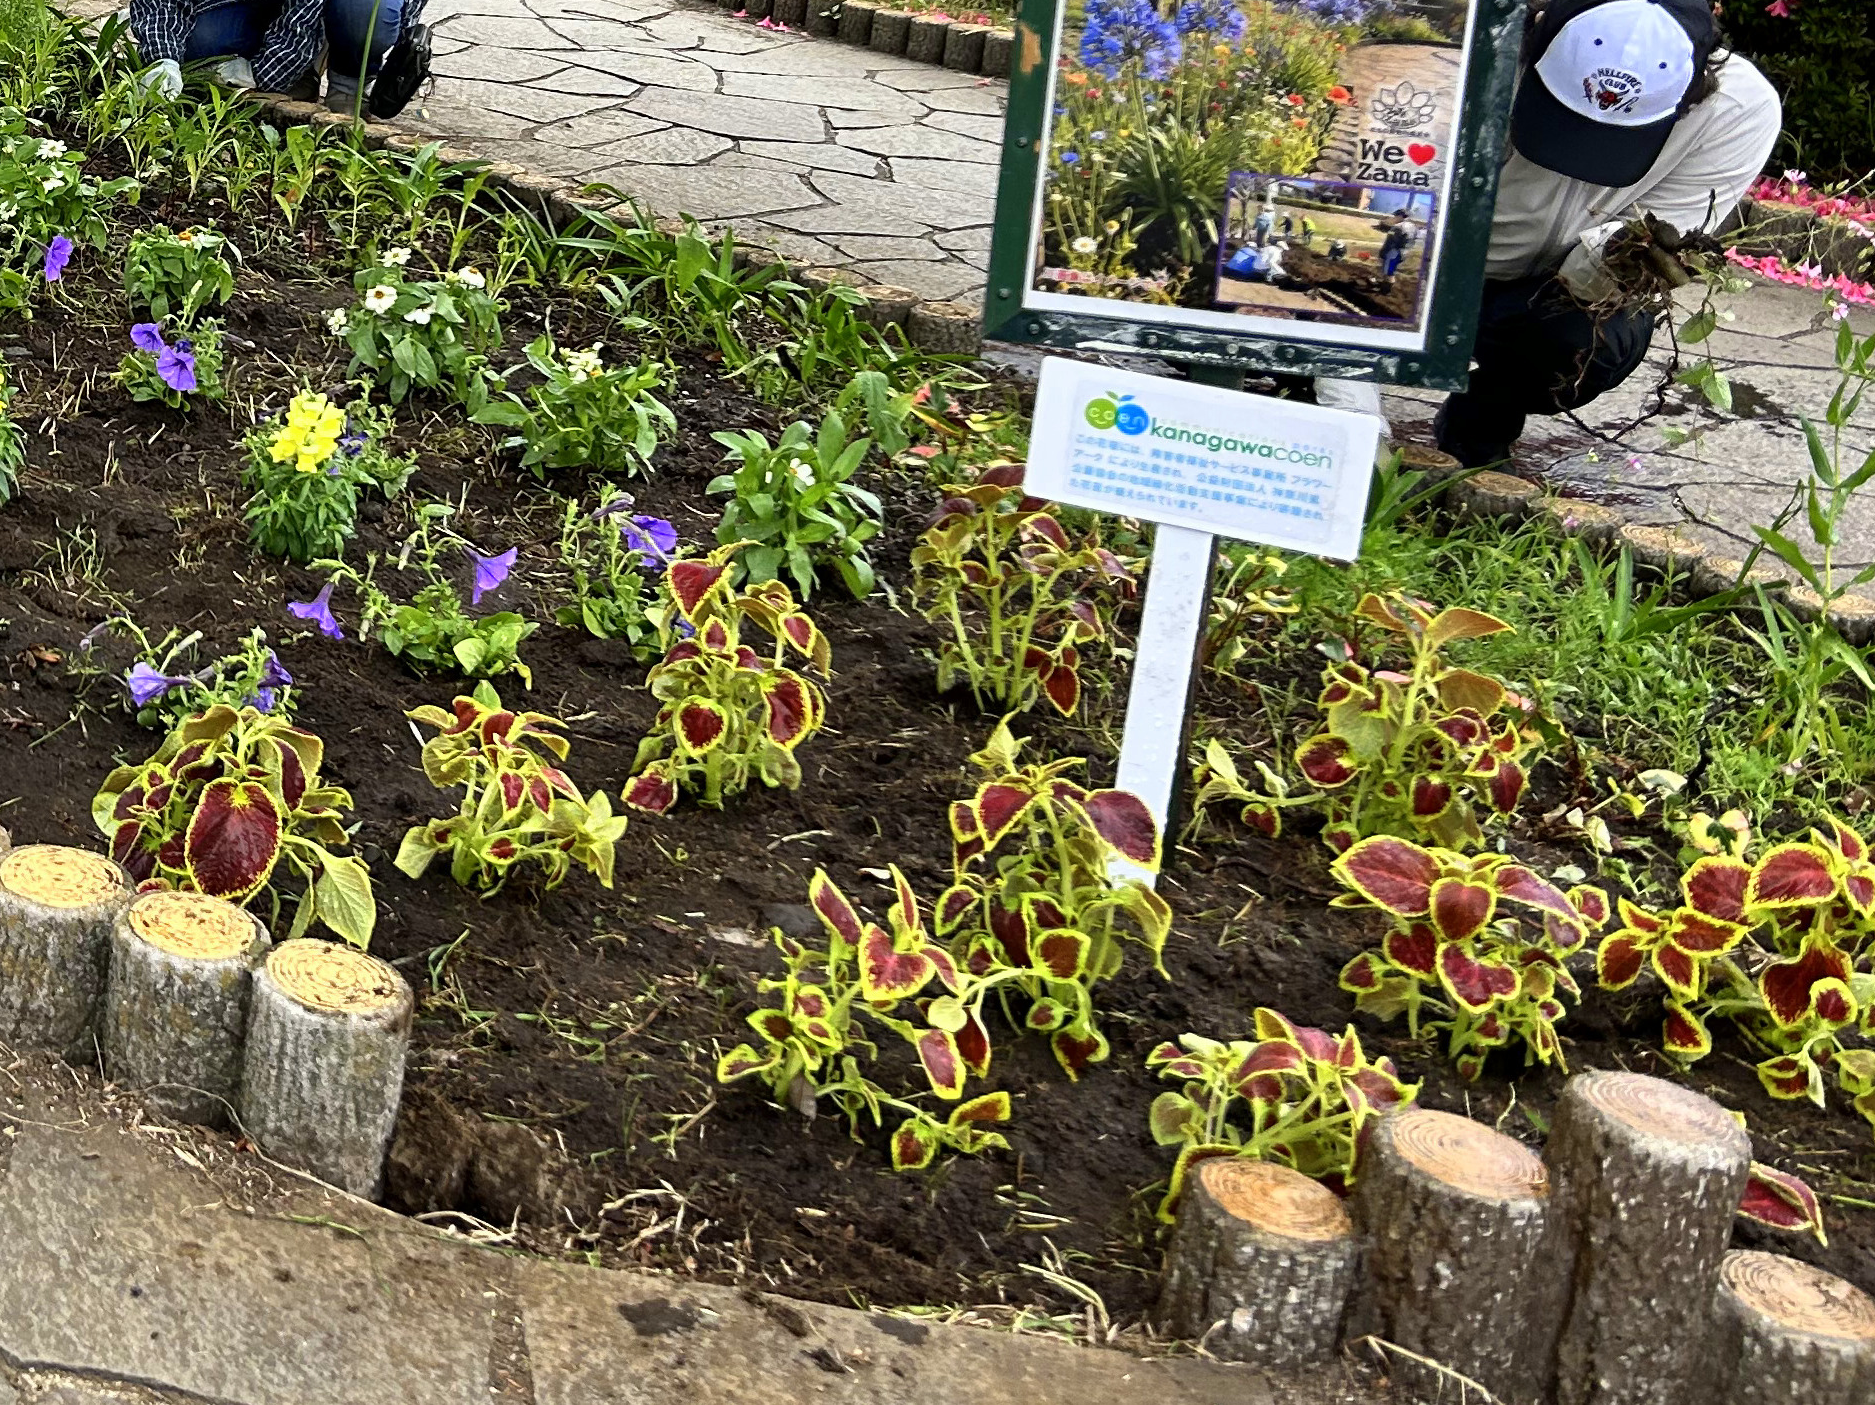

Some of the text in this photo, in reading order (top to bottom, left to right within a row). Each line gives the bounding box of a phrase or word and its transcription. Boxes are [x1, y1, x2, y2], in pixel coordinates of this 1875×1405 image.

[1597, 67, 1643, 89] HELLFIRE
[1604, 78, 1627, 91] CLUB
[1359, 138, 1405, 165] We
[1355, 162, 1430, 188] Zama
[1149, 417, 1332, 470] kanagawacoen
